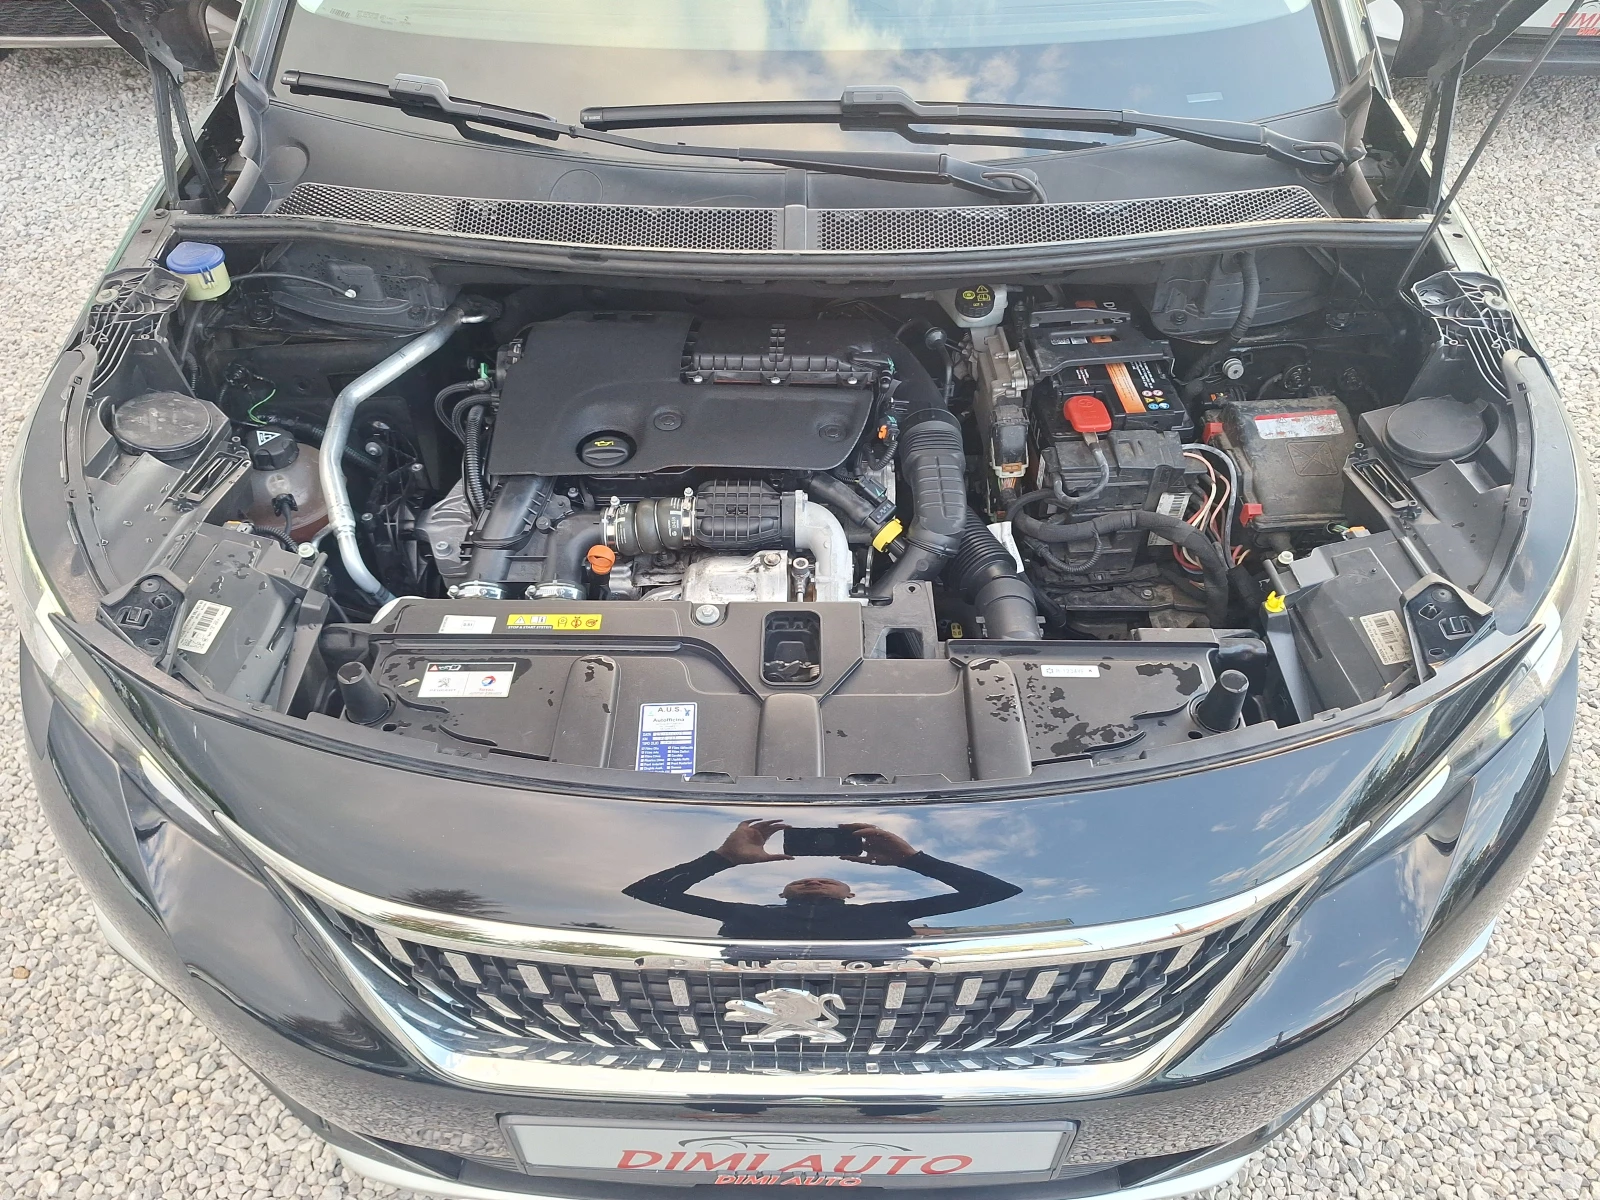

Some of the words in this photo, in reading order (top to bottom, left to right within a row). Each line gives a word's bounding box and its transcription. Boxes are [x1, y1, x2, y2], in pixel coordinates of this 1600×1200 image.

[617, 1150, 770, 1171] DIMI
[778, 1154, 973, 1175] AUTO
[715, 1174, 783, 1185] DIMI
[780, 1176, 863, 1187] AUTO
